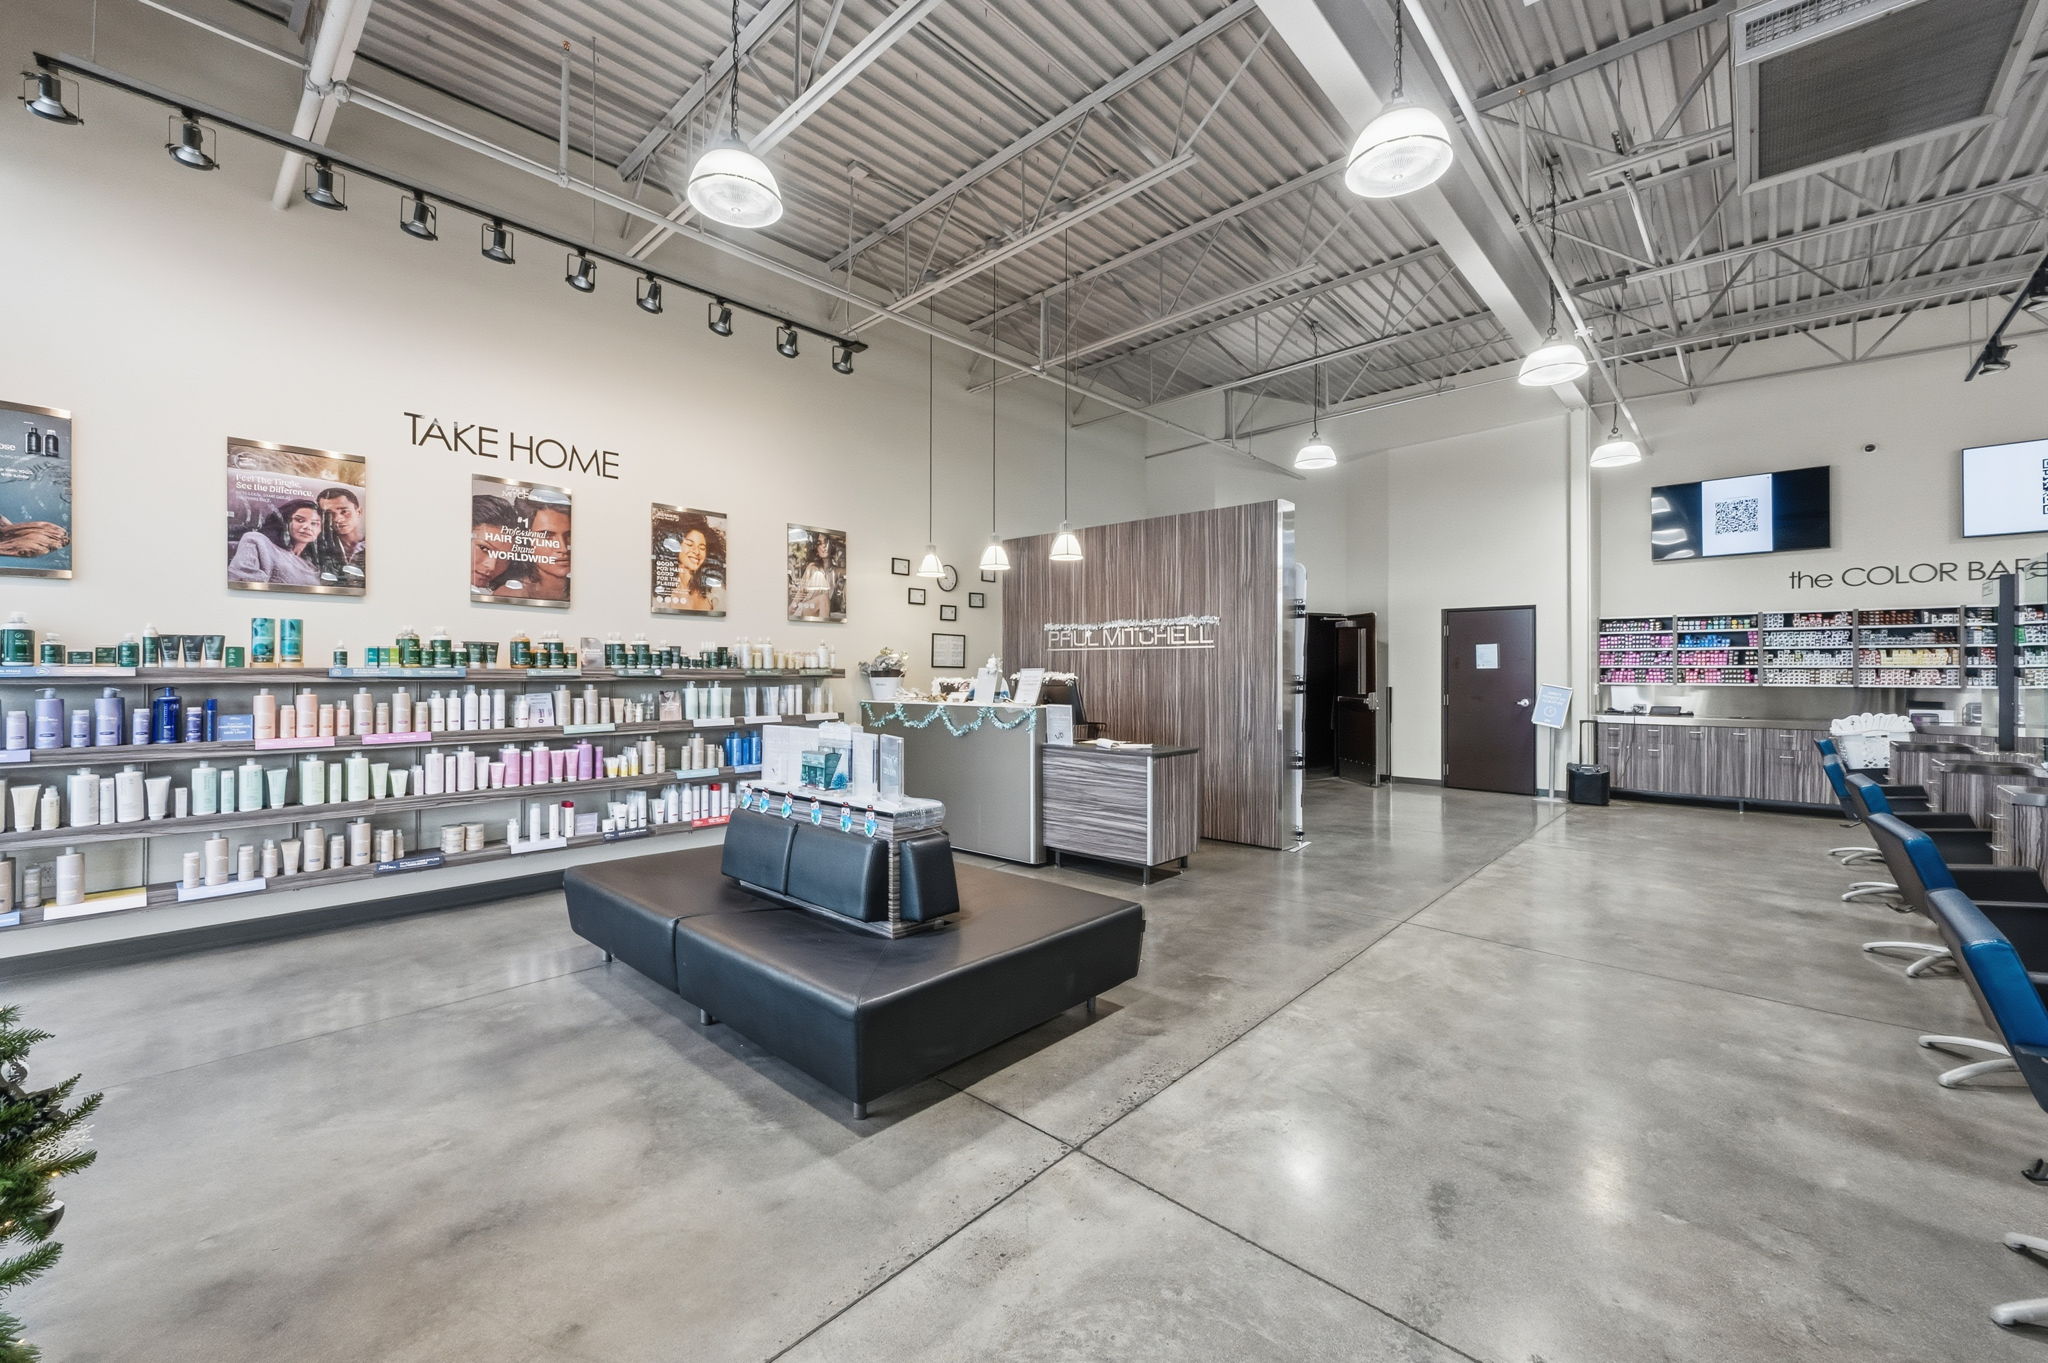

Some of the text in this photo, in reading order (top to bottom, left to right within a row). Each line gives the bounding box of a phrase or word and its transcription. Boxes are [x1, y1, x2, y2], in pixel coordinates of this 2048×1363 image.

[404, 411, 619, 480] TAKE HOME
[235, 481, 253, 490] See
[500, 525, 548, 539] Professional
[485, 533, 560, 549] HAIR STYLING
[511, 544, 536, 554] Brand
[488, 550, 556, 565] WORLDWIDE
[1788, 570, 1833, 590] the
[1841, 562, 1958, 587] COLOR
[1048, 625, 1214, 647] PAUL MITCHELL
